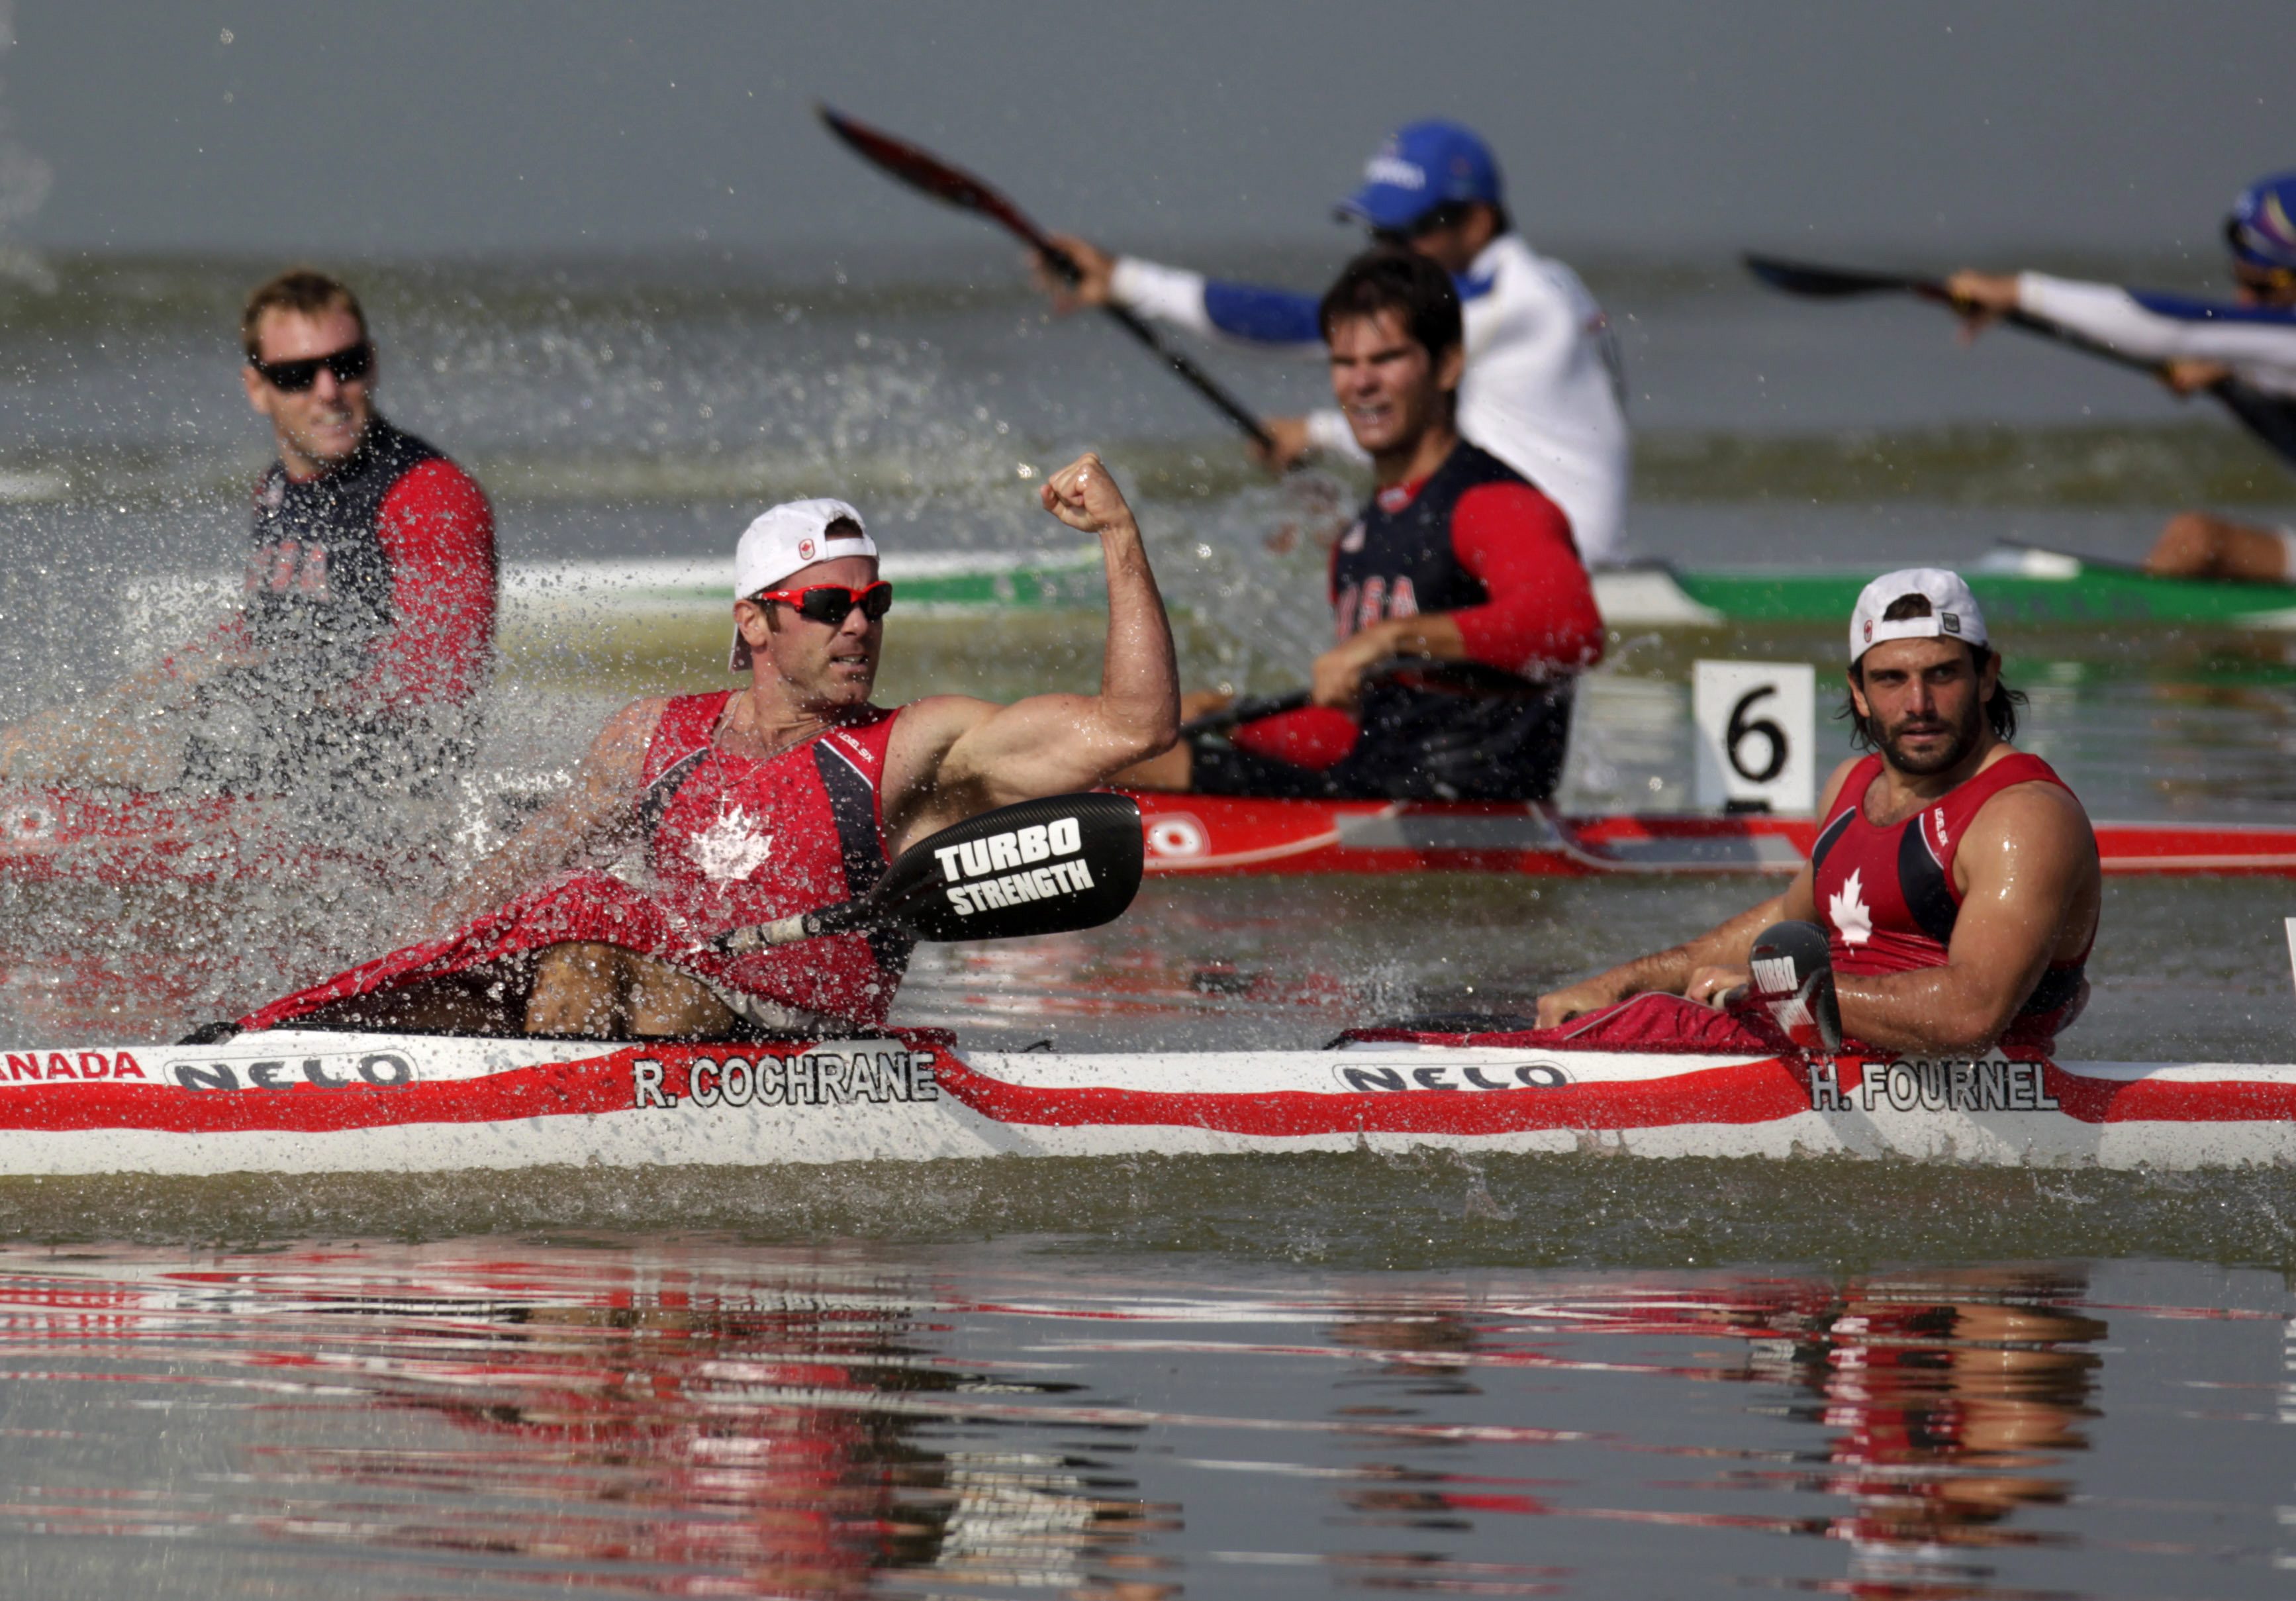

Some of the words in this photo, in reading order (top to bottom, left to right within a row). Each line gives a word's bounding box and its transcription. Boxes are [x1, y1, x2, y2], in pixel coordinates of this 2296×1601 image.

[1727, 683, 1790, 784] 6
[934, 817, 1081, 882] TURBO
[947, 859, 1094, 915] STRENGTH
[174, 1054, 412, 1091] NELO
[633, 1058, 678, 1108] R.
[689, 1052, 939, 1108] COCHRANE
[1343, 1065, 1568, 1091] NELO
[1808, 1062, 1852, 1111] H.
[1860, 1060, 2060, 1112] FOURNEL
